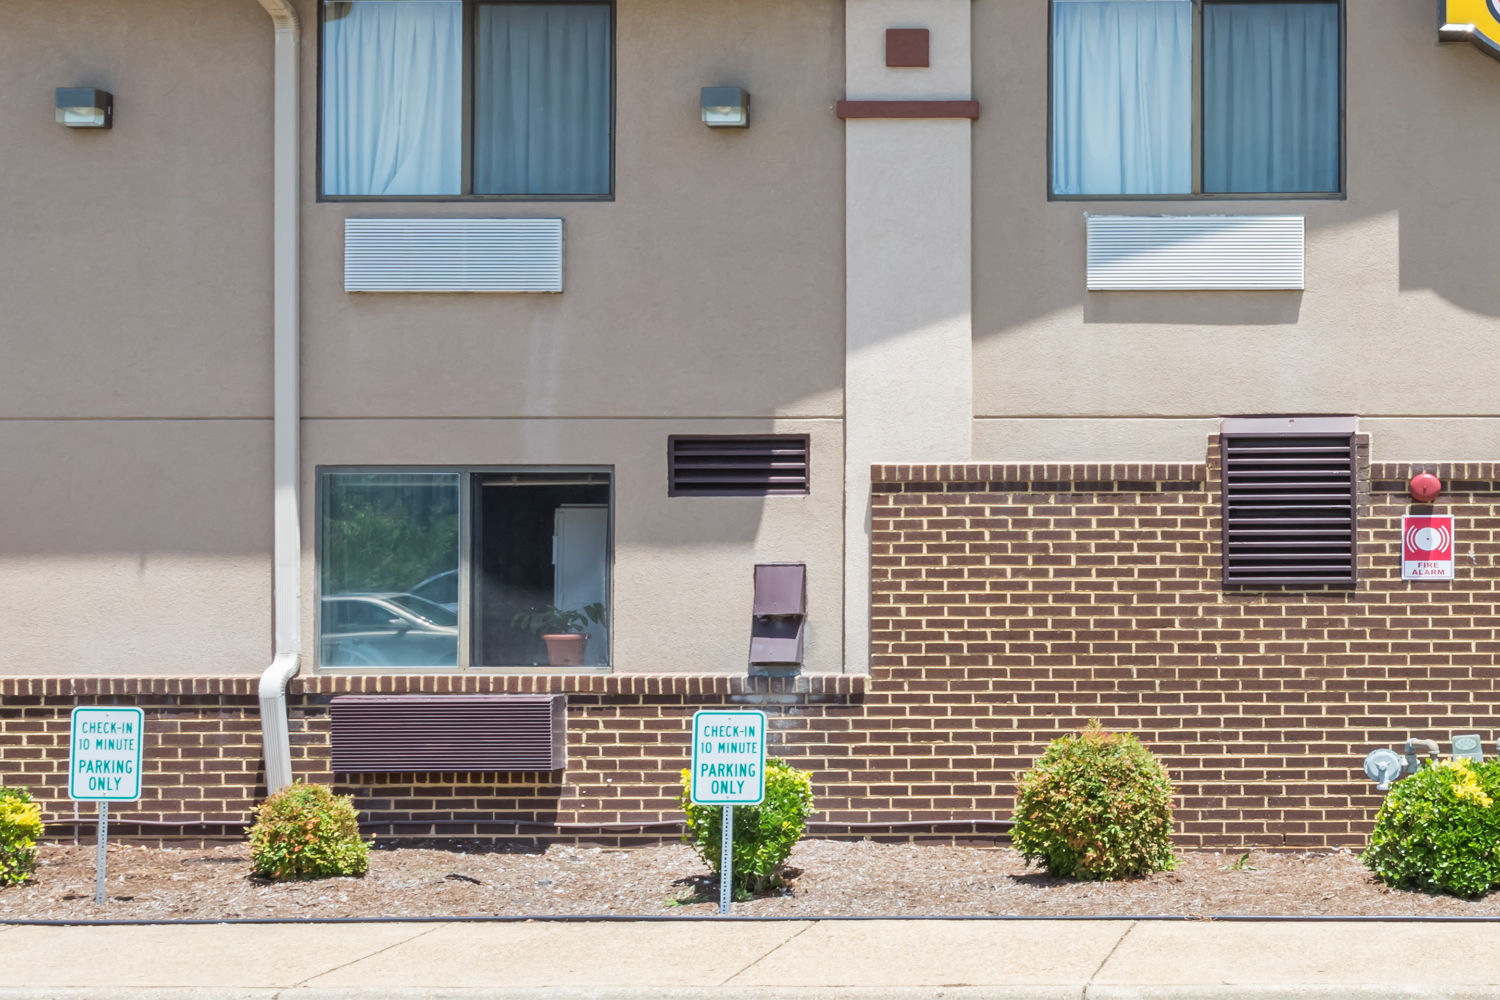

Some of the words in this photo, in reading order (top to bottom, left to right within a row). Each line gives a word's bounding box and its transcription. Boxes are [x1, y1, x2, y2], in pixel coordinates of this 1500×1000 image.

[81, 722, 133, 734] CHECK-IN
[703, 725, 756, 737] CHECK-IN
[79, 738, 90, 750] 10
[95, 738, 135, 750] MINUTE
[701, 742, 712, 754] 10
[718, 742, 757, 754] MINUTE
[78, 759, 133, 774] PARKING
[700, 763, 756, 777] PARKING
[88, 776, 122, 791] ONLY
[711, 780, 745, 794] ONLY
